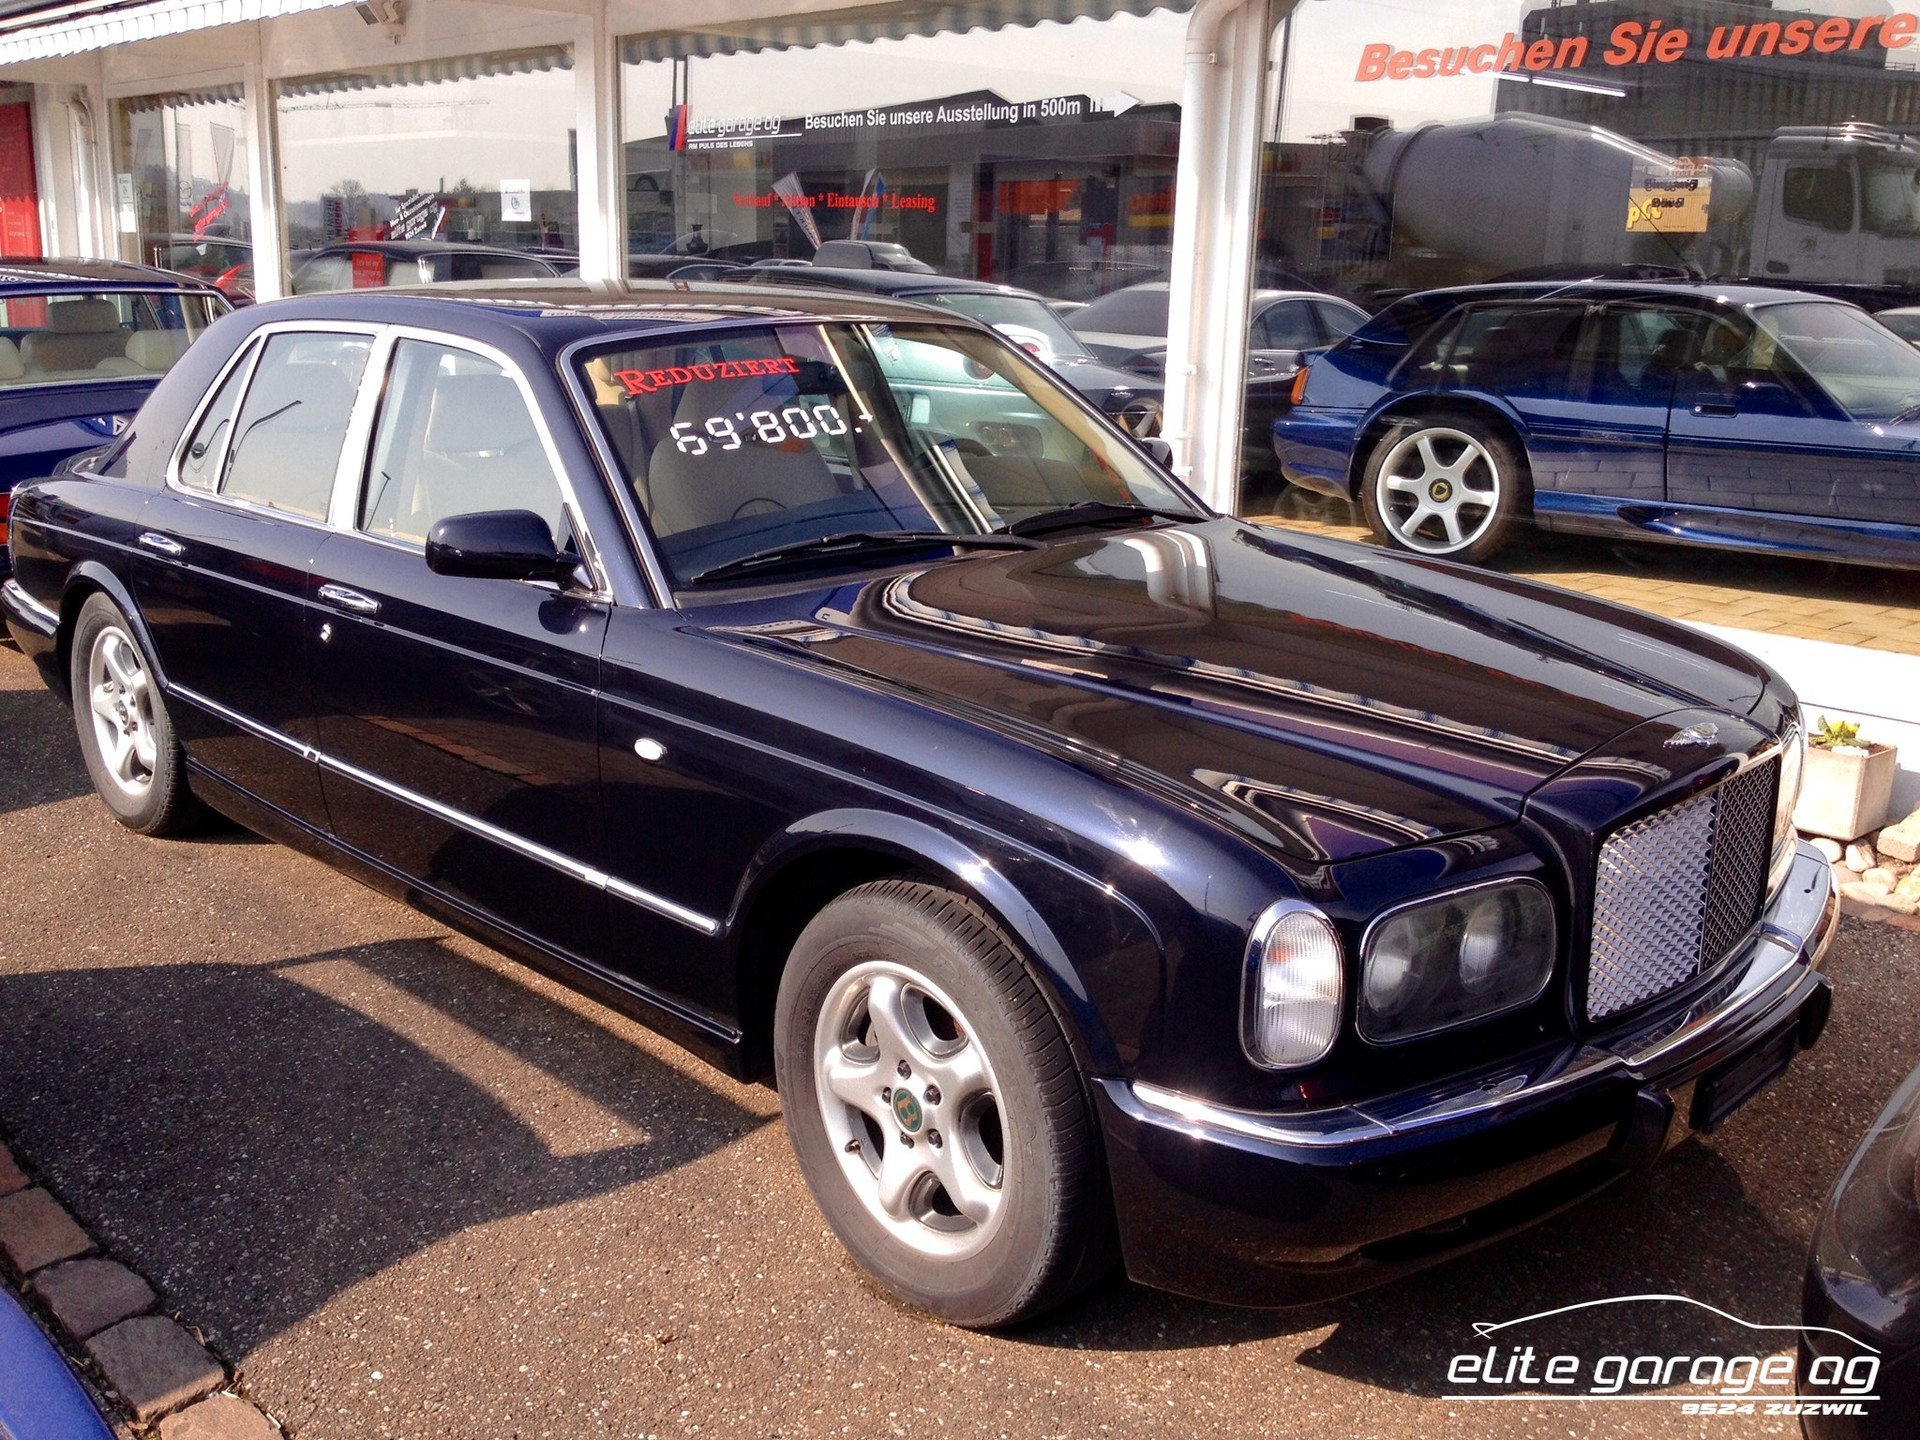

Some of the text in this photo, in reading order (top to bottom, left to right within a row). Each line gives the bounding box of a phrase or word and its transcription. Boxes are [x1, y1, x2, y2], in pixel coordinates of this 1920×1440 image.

[1354, 12, 1919, 83] Besuchen Sie unsere
[688, 113, 781, 138] elite garage ag
[804, 98, 1081, 130] Besuchen Sie unsere Ausstellung in 500m
[729, 140, 753, 148] LEBENS
[827, 192, 879, 208] Eintausch
[892, 192, 936, 213] Leasing
[614, 357, 799, 396] REDUZIERT
